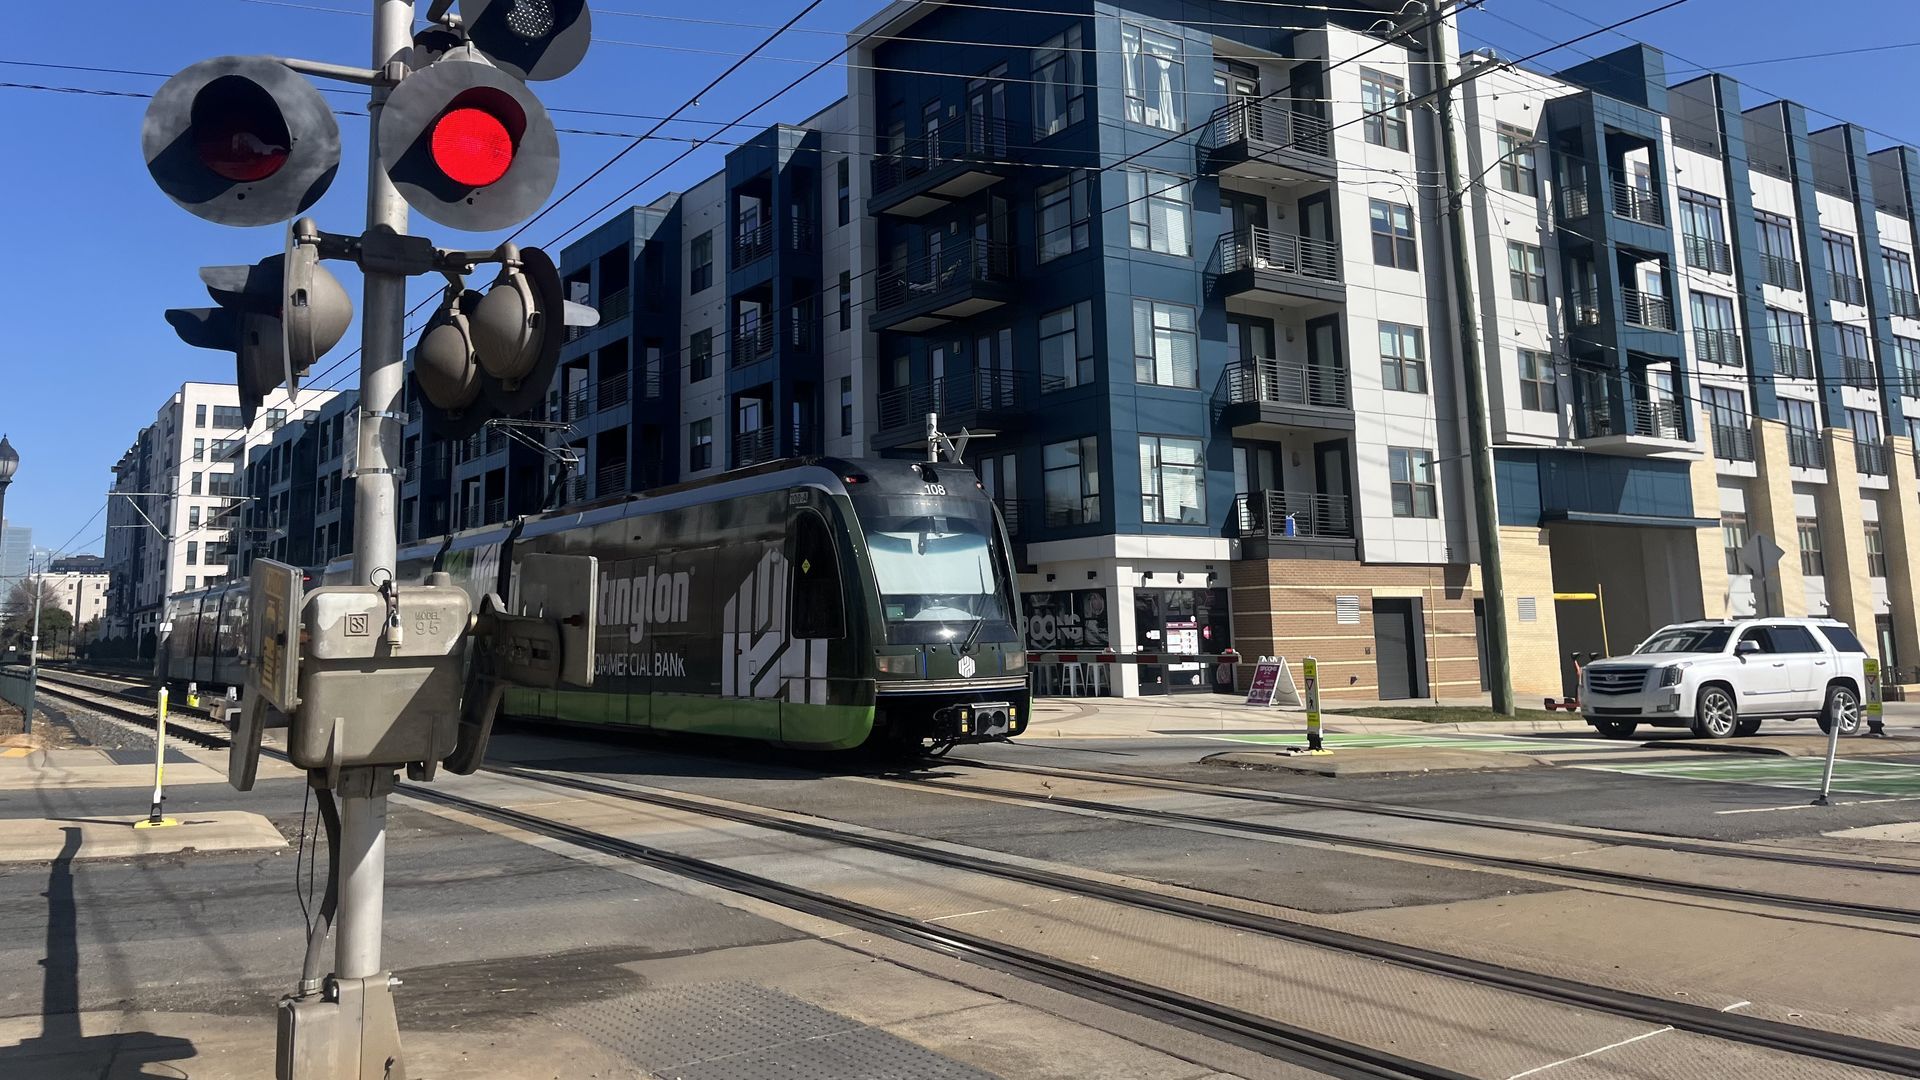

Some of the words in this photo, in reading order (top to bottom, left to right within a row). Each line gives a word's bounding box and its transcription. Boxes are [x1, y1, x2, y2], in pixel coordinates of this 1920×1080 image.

[924, 484, 946, 496] 108
[415, 611, 440, 620] MODEL
[415, 620, 441, 636] 95
[654, 652, 686, 677] BANK
